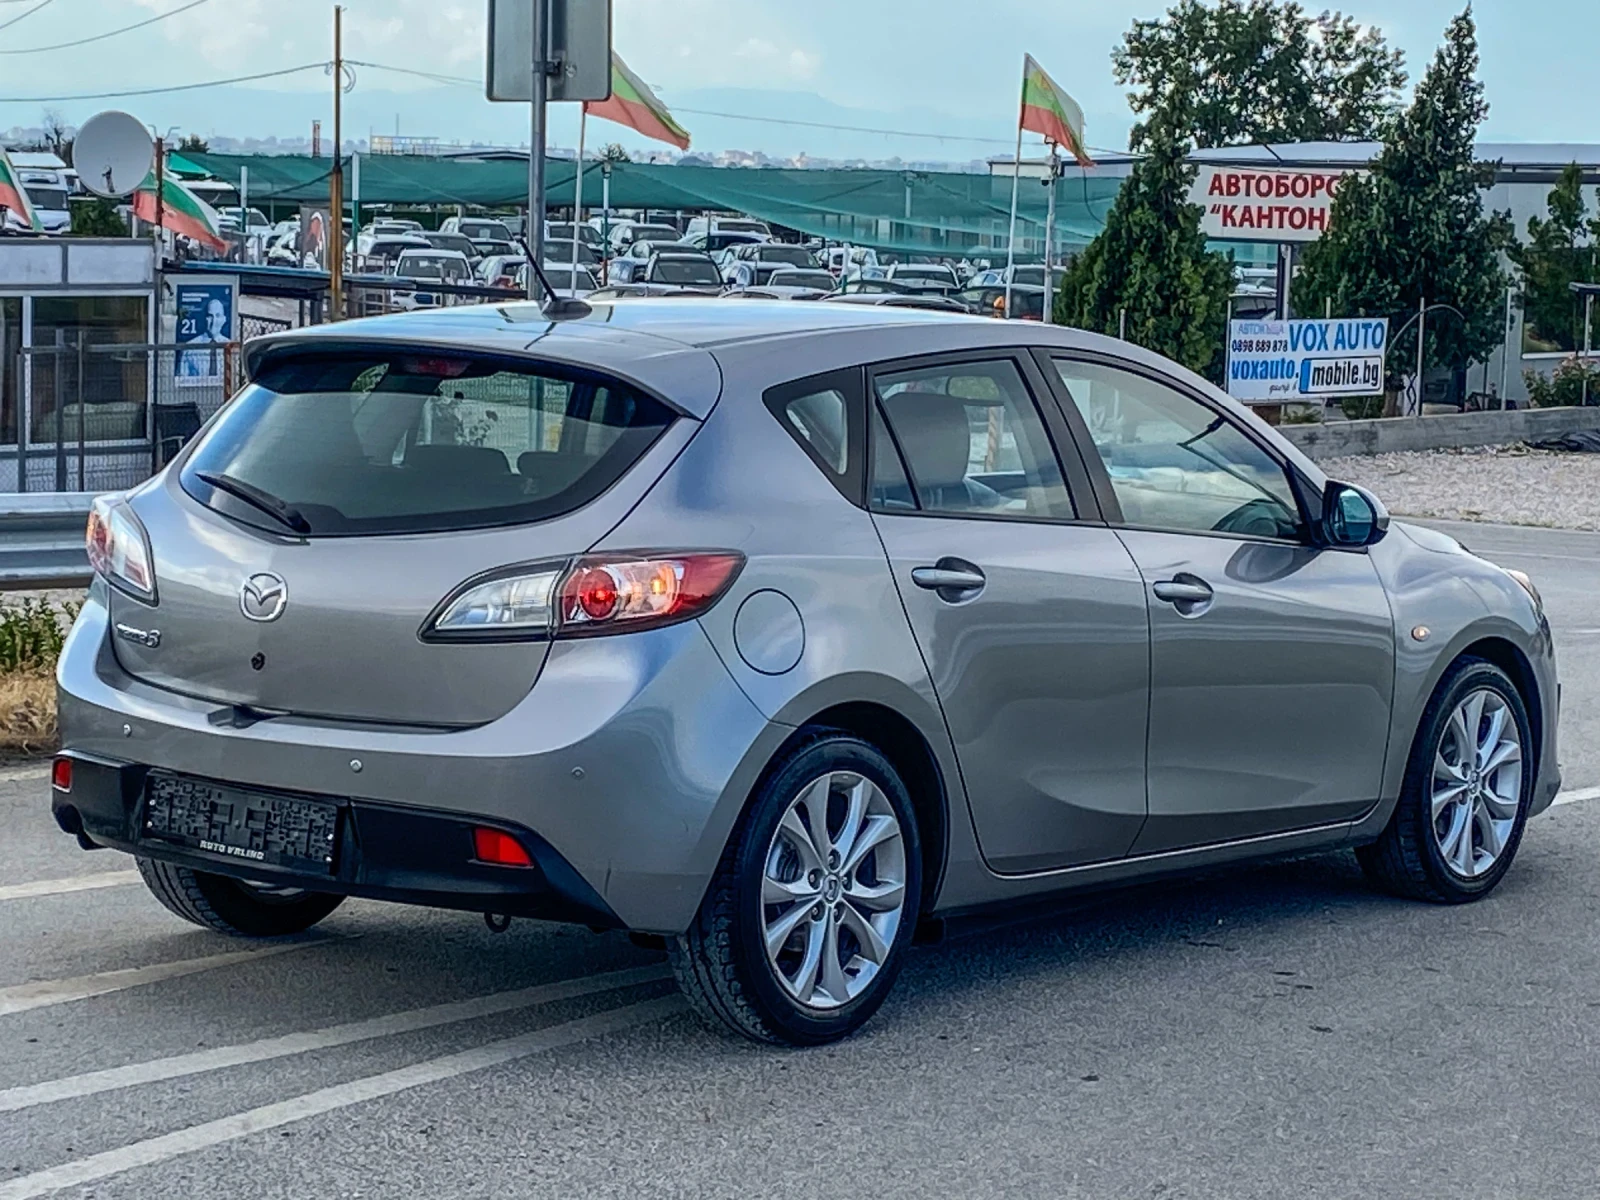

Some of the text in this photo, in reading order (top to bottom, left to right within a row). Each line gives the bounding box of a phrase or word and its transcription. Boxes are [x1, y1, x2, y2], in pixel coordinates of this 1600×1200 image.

[1208, 173, 1341, 199] АВТОБОРС
[1210, 203, 1331, 231] “КАНТОН
[181, 319, 197, 334] 21
[1289, 321, 1385, 352] VOX AUTO
[1311, 360, 1379, 387] mobile.bg
